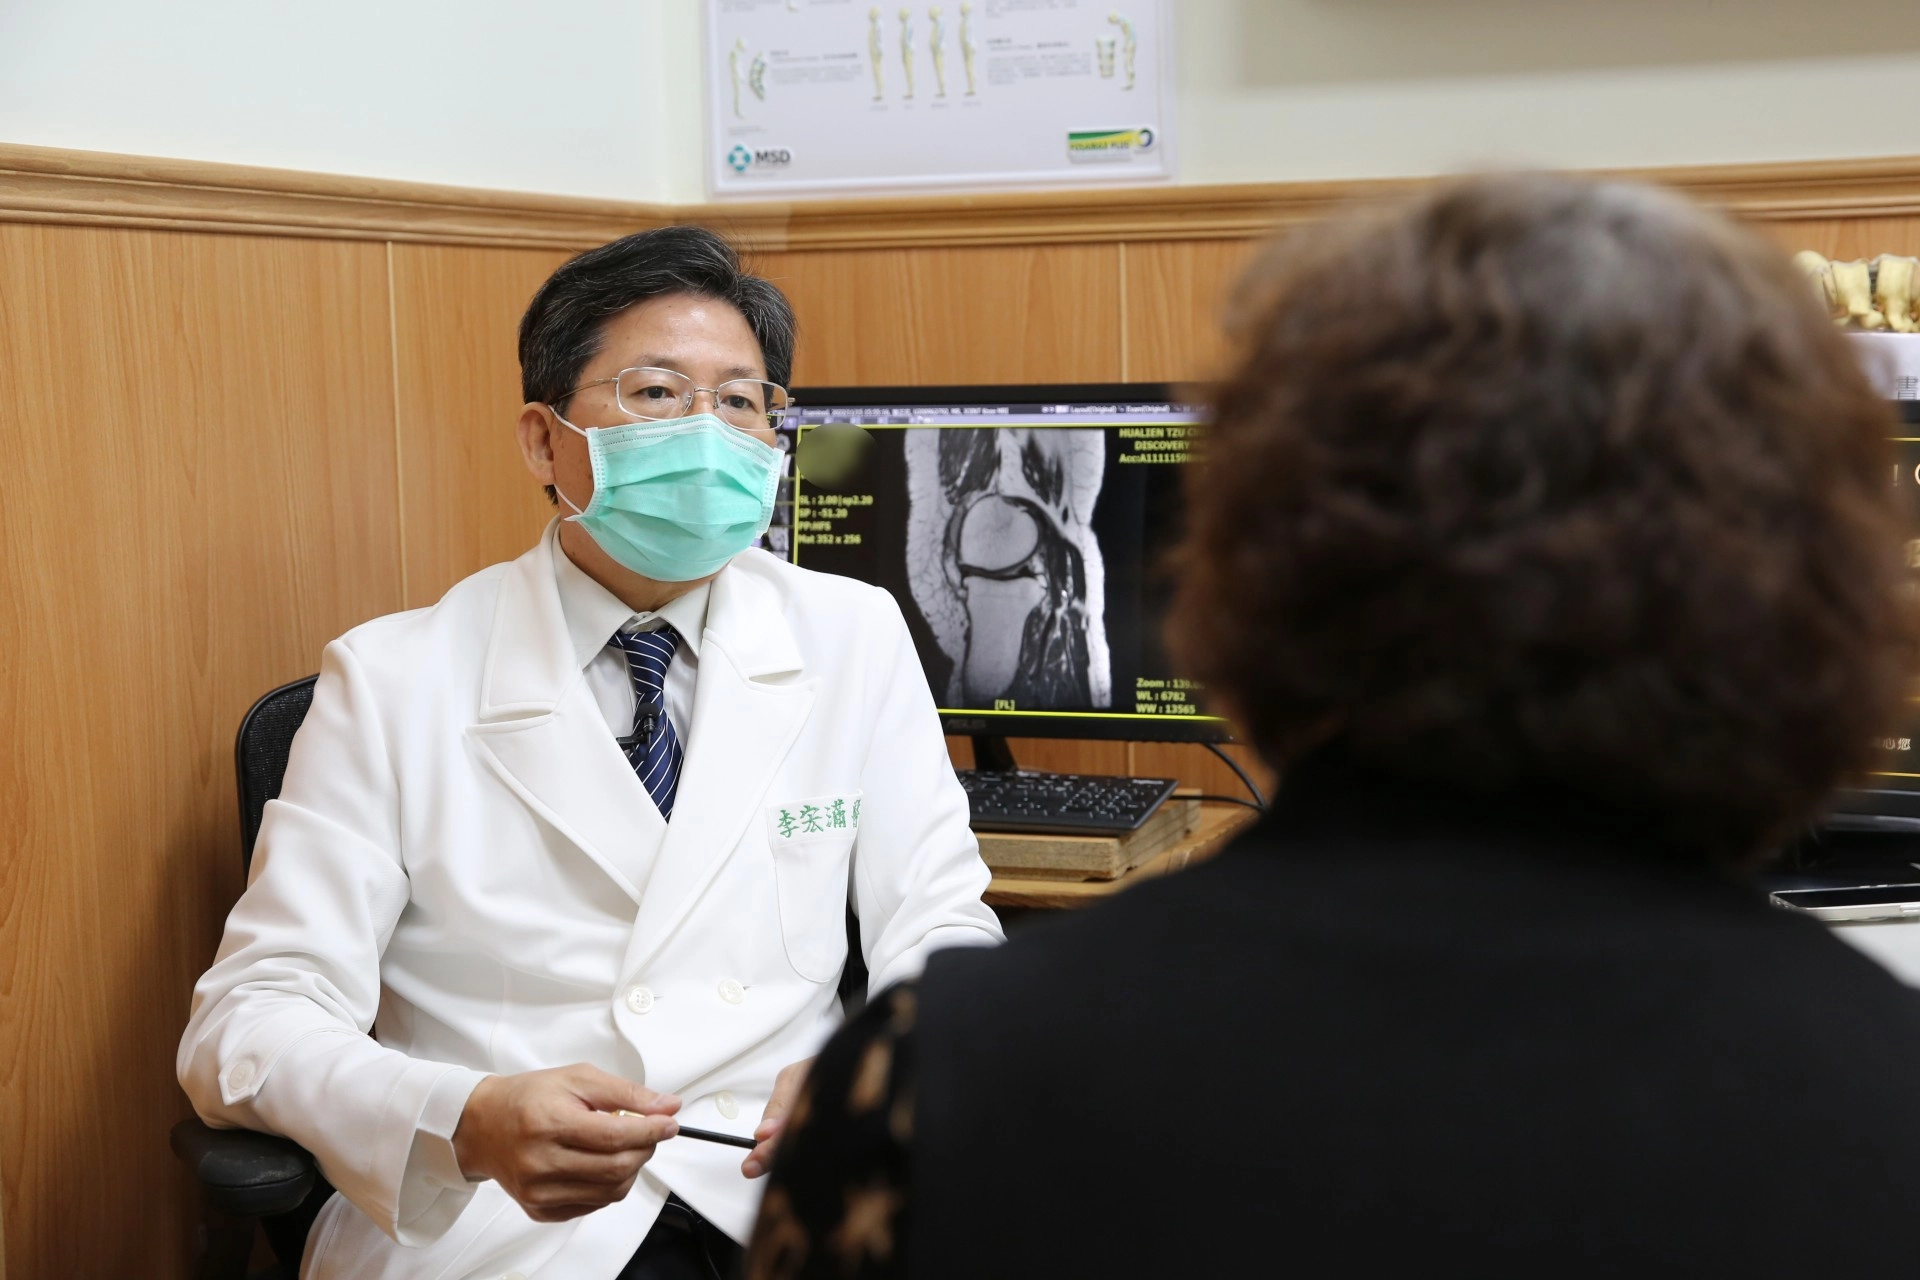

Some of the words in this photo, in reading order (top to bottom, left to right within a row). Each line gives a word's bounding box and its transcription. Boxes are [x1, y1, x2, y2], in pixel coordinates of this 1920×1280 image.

[755, 149, 791, 164] MSD
[1119, 427, 1164, 438] HUALIEN
[1166, 427, 1186, 438] TZU
[1134, 440, 1190, 451] DISCOVERY
[1136, 677, 1165, 688] Zoom
[1136, 690, 1153, 701] WL
[1160, 691, 1186, 702] 6782
[1135, 703, 1157, 713] WW
[1165, 703, 1196, 714] 13565
